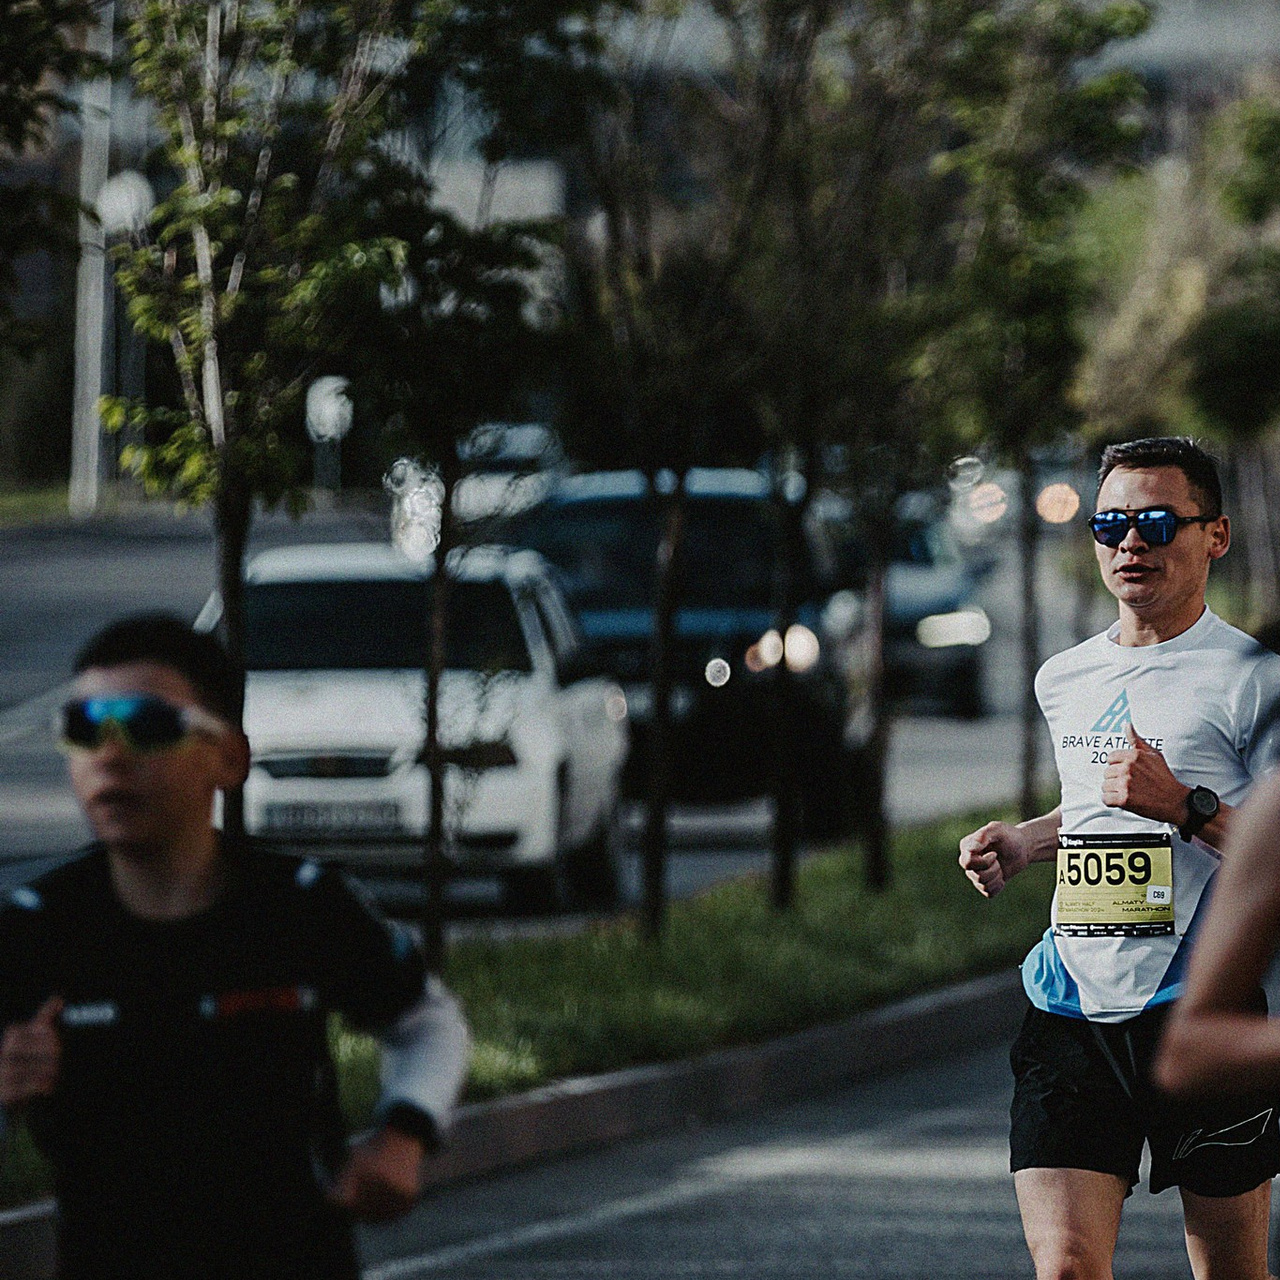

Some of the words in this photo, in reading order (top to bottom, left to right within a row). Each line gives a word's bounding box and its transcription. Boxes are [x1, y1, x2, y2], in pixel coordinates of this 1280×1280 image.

[1062, 736, 1101, 748] BRAVE
[1103, 737, 1164, 752] ATHTE
[1091, 751, 1108, 764] 20
[1059, 869, 1066, 885] A
[1067, 851, 1152, 886] 5059
